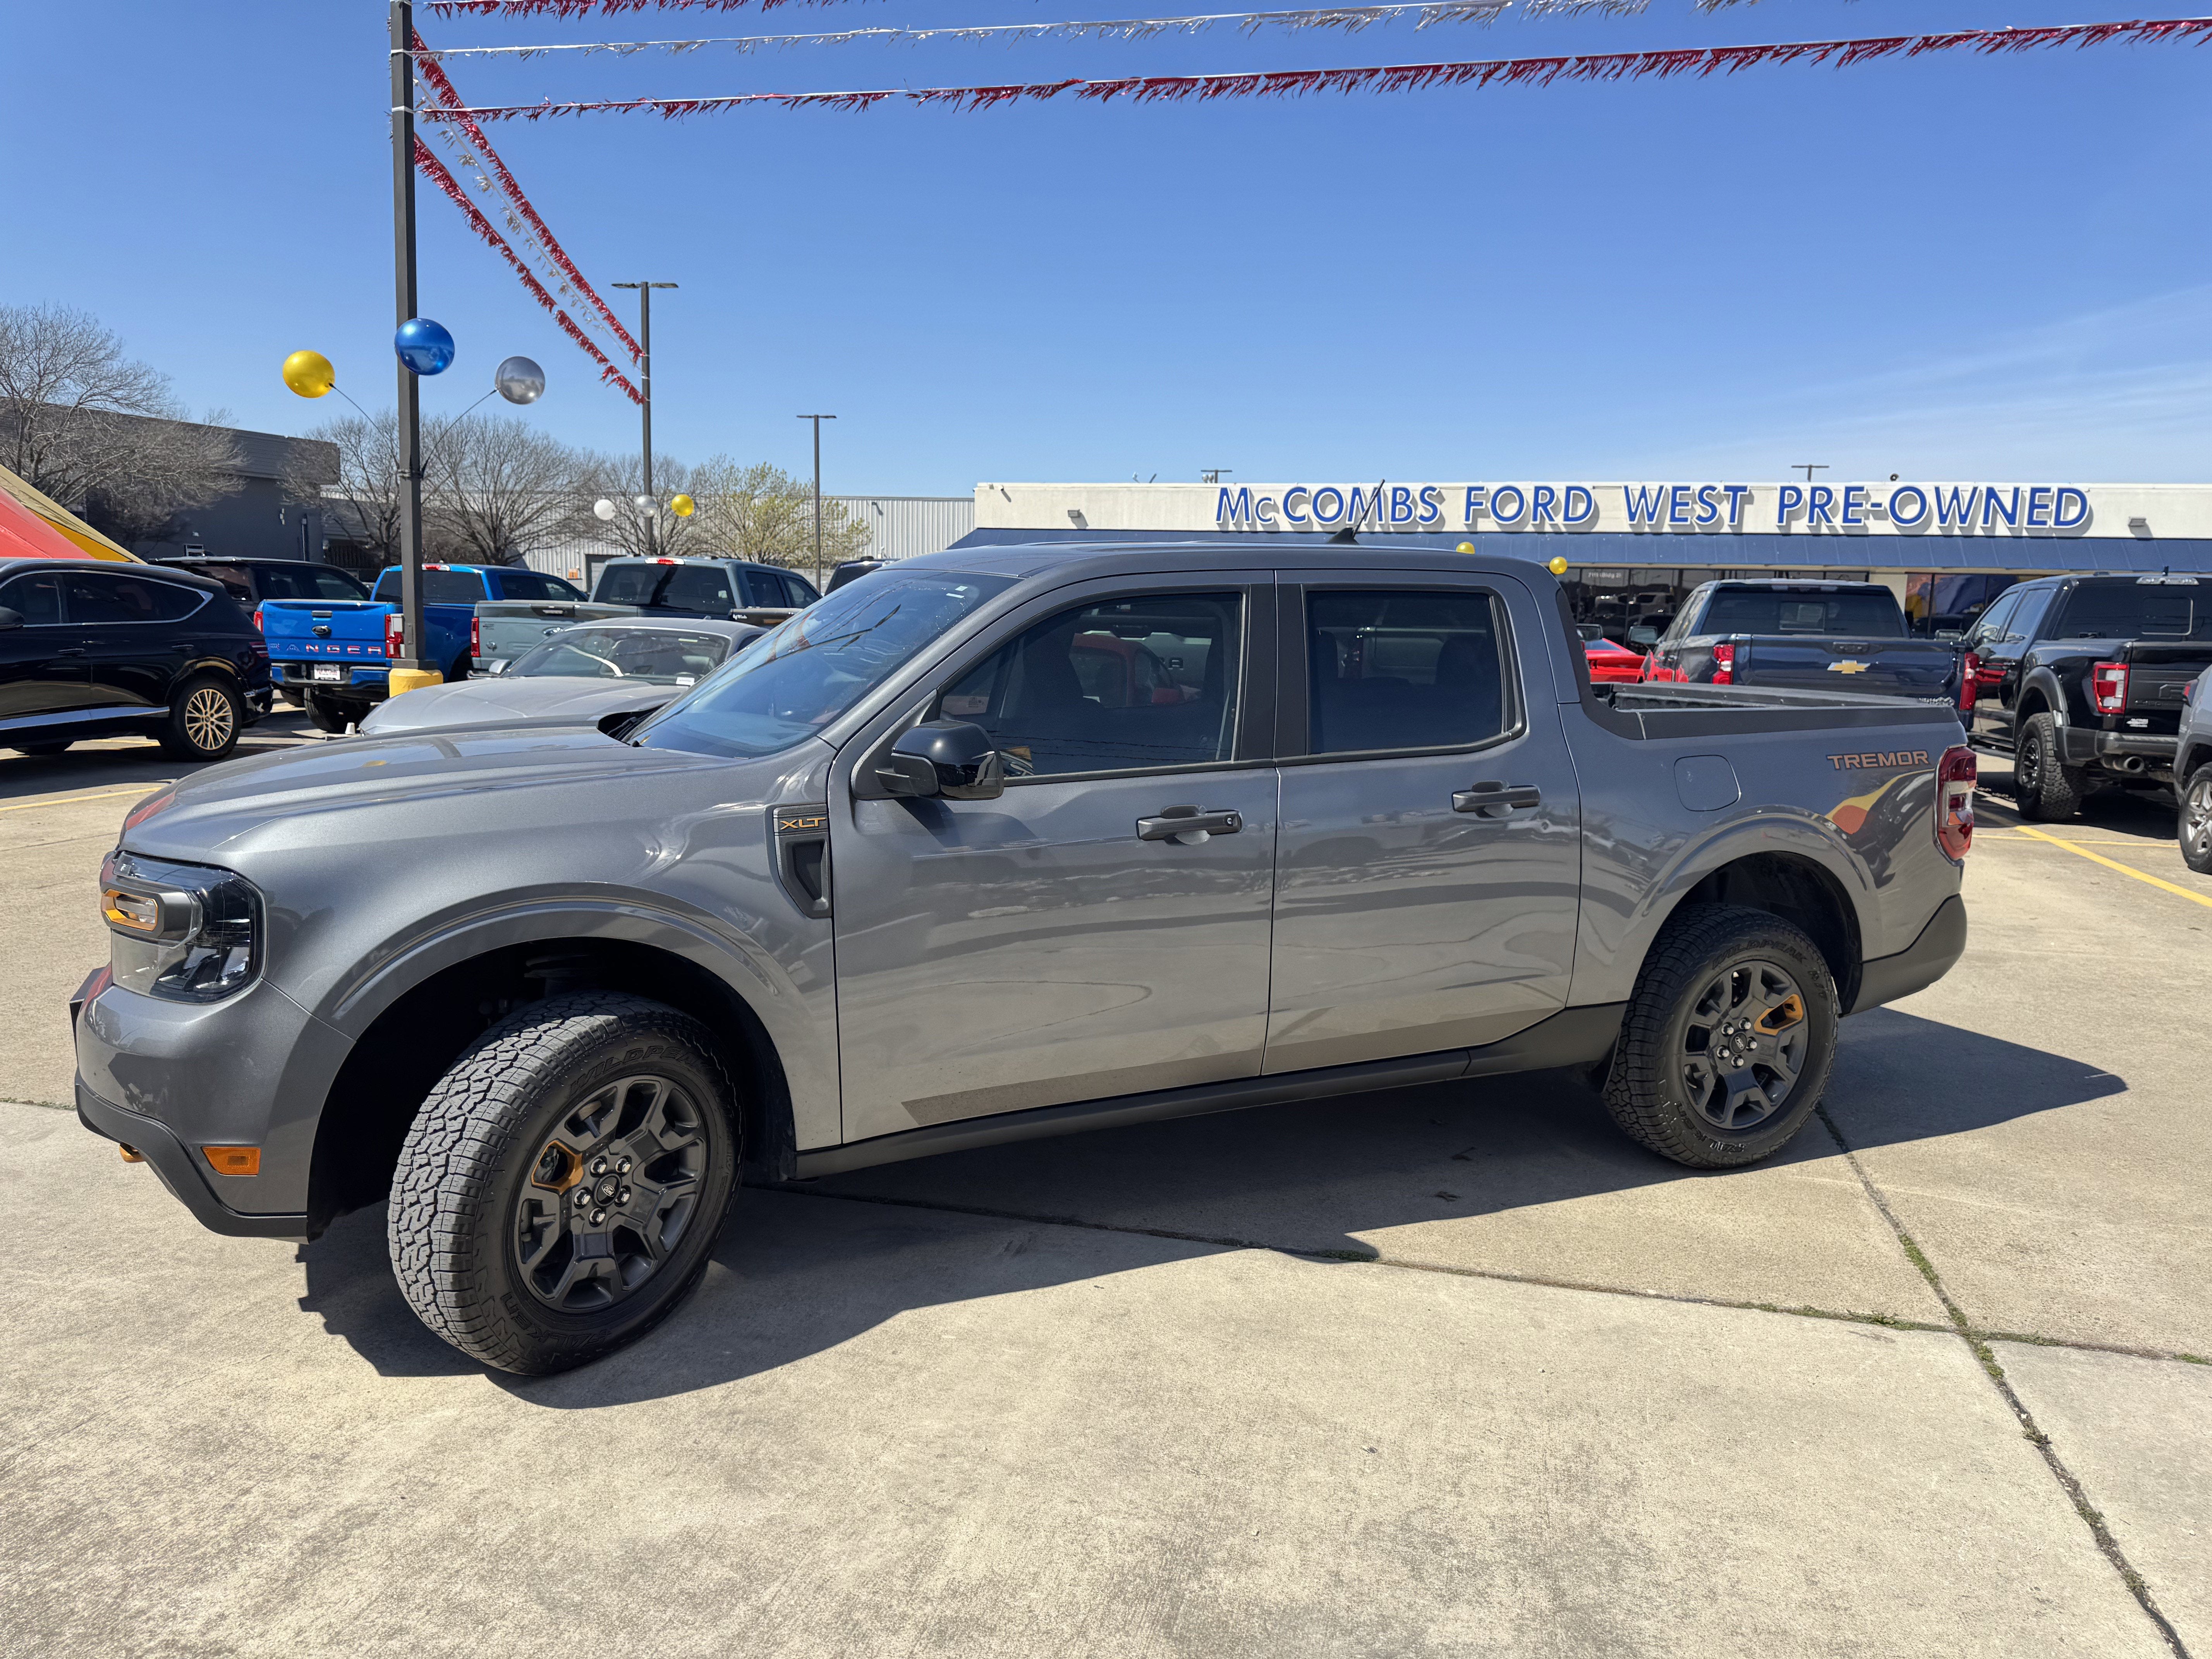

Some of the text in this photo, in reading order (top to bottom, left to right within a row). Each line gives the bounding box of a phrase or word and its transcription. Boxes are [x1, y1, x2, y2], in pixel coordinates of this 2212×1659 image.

[1217, 486, 2088, 527] McCOMBS FORD WEST PRE-OWNED
[268, 643, 382, 655] RANGER
[1827, 750, 1929, 770] TREMOR
[780, 817, 826, 830] XLT
[570, 1046, 704, 1096] WILDPEA
